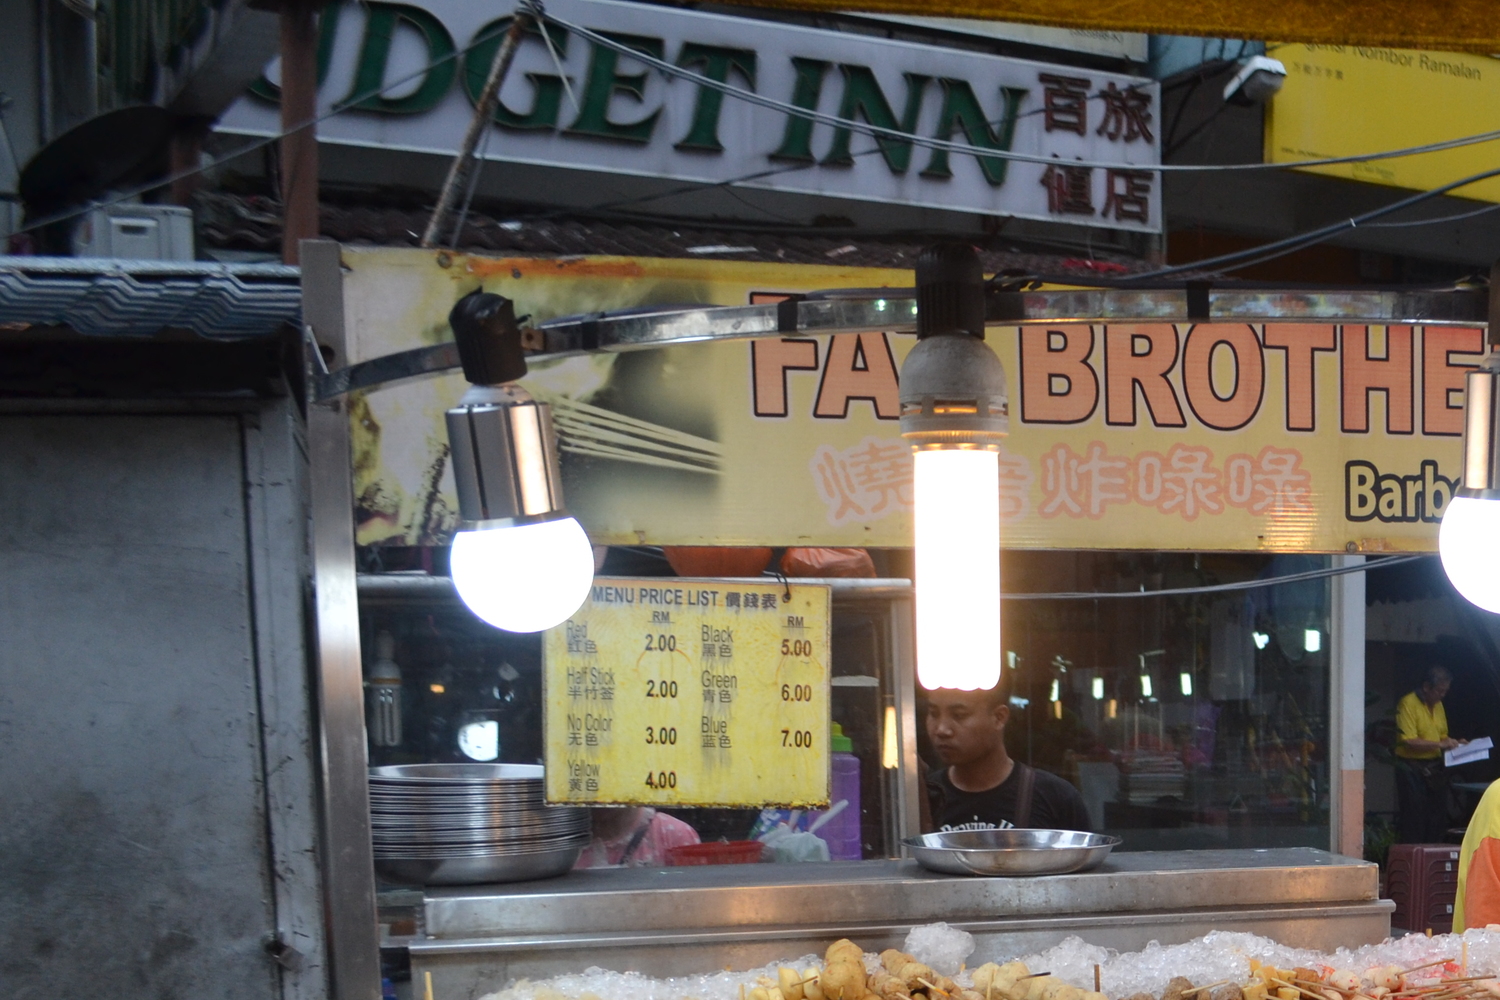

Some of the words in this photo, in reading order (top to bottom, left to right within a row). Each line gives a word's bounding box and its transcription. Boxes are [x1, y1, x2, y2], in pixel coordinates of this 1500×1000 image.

[1419, 53, 1482, 81] Ramalan
[769, 57, 1029, 187] INN
[750, 292, 918, 420] FA
[592, 586, 635, 604] MENU
[639, 588, 683, 606] PRICE
[688, 590, 719, 607] LIST
[652, 610, 670, 622] RM
[787, 615, 804, 627] RM
[566, 619, 589, 638] Red
[645, 633, 677, 652] 2.00
[701, 624, 734, 643] Black
[780, 638, 812, 657] 5.00
[566, 666, 588, 685] Half
[590, 666, 616, 685] Stick
[646, 680, 678, 698] 2.00
[701, 670, 738, 689] Green
[781, 684, 812, 702] 6.00
[567, 713, 582, 731] No
[585, 713, 613, 732] Color
[645, 726, 677, 745] 3.00
[701, 716, 728, 734] Blue
[781, 730, 812, 748] 7.00
[567, 759, 601, 777] Yellow
[645, 771, 677, 789] 4.00
